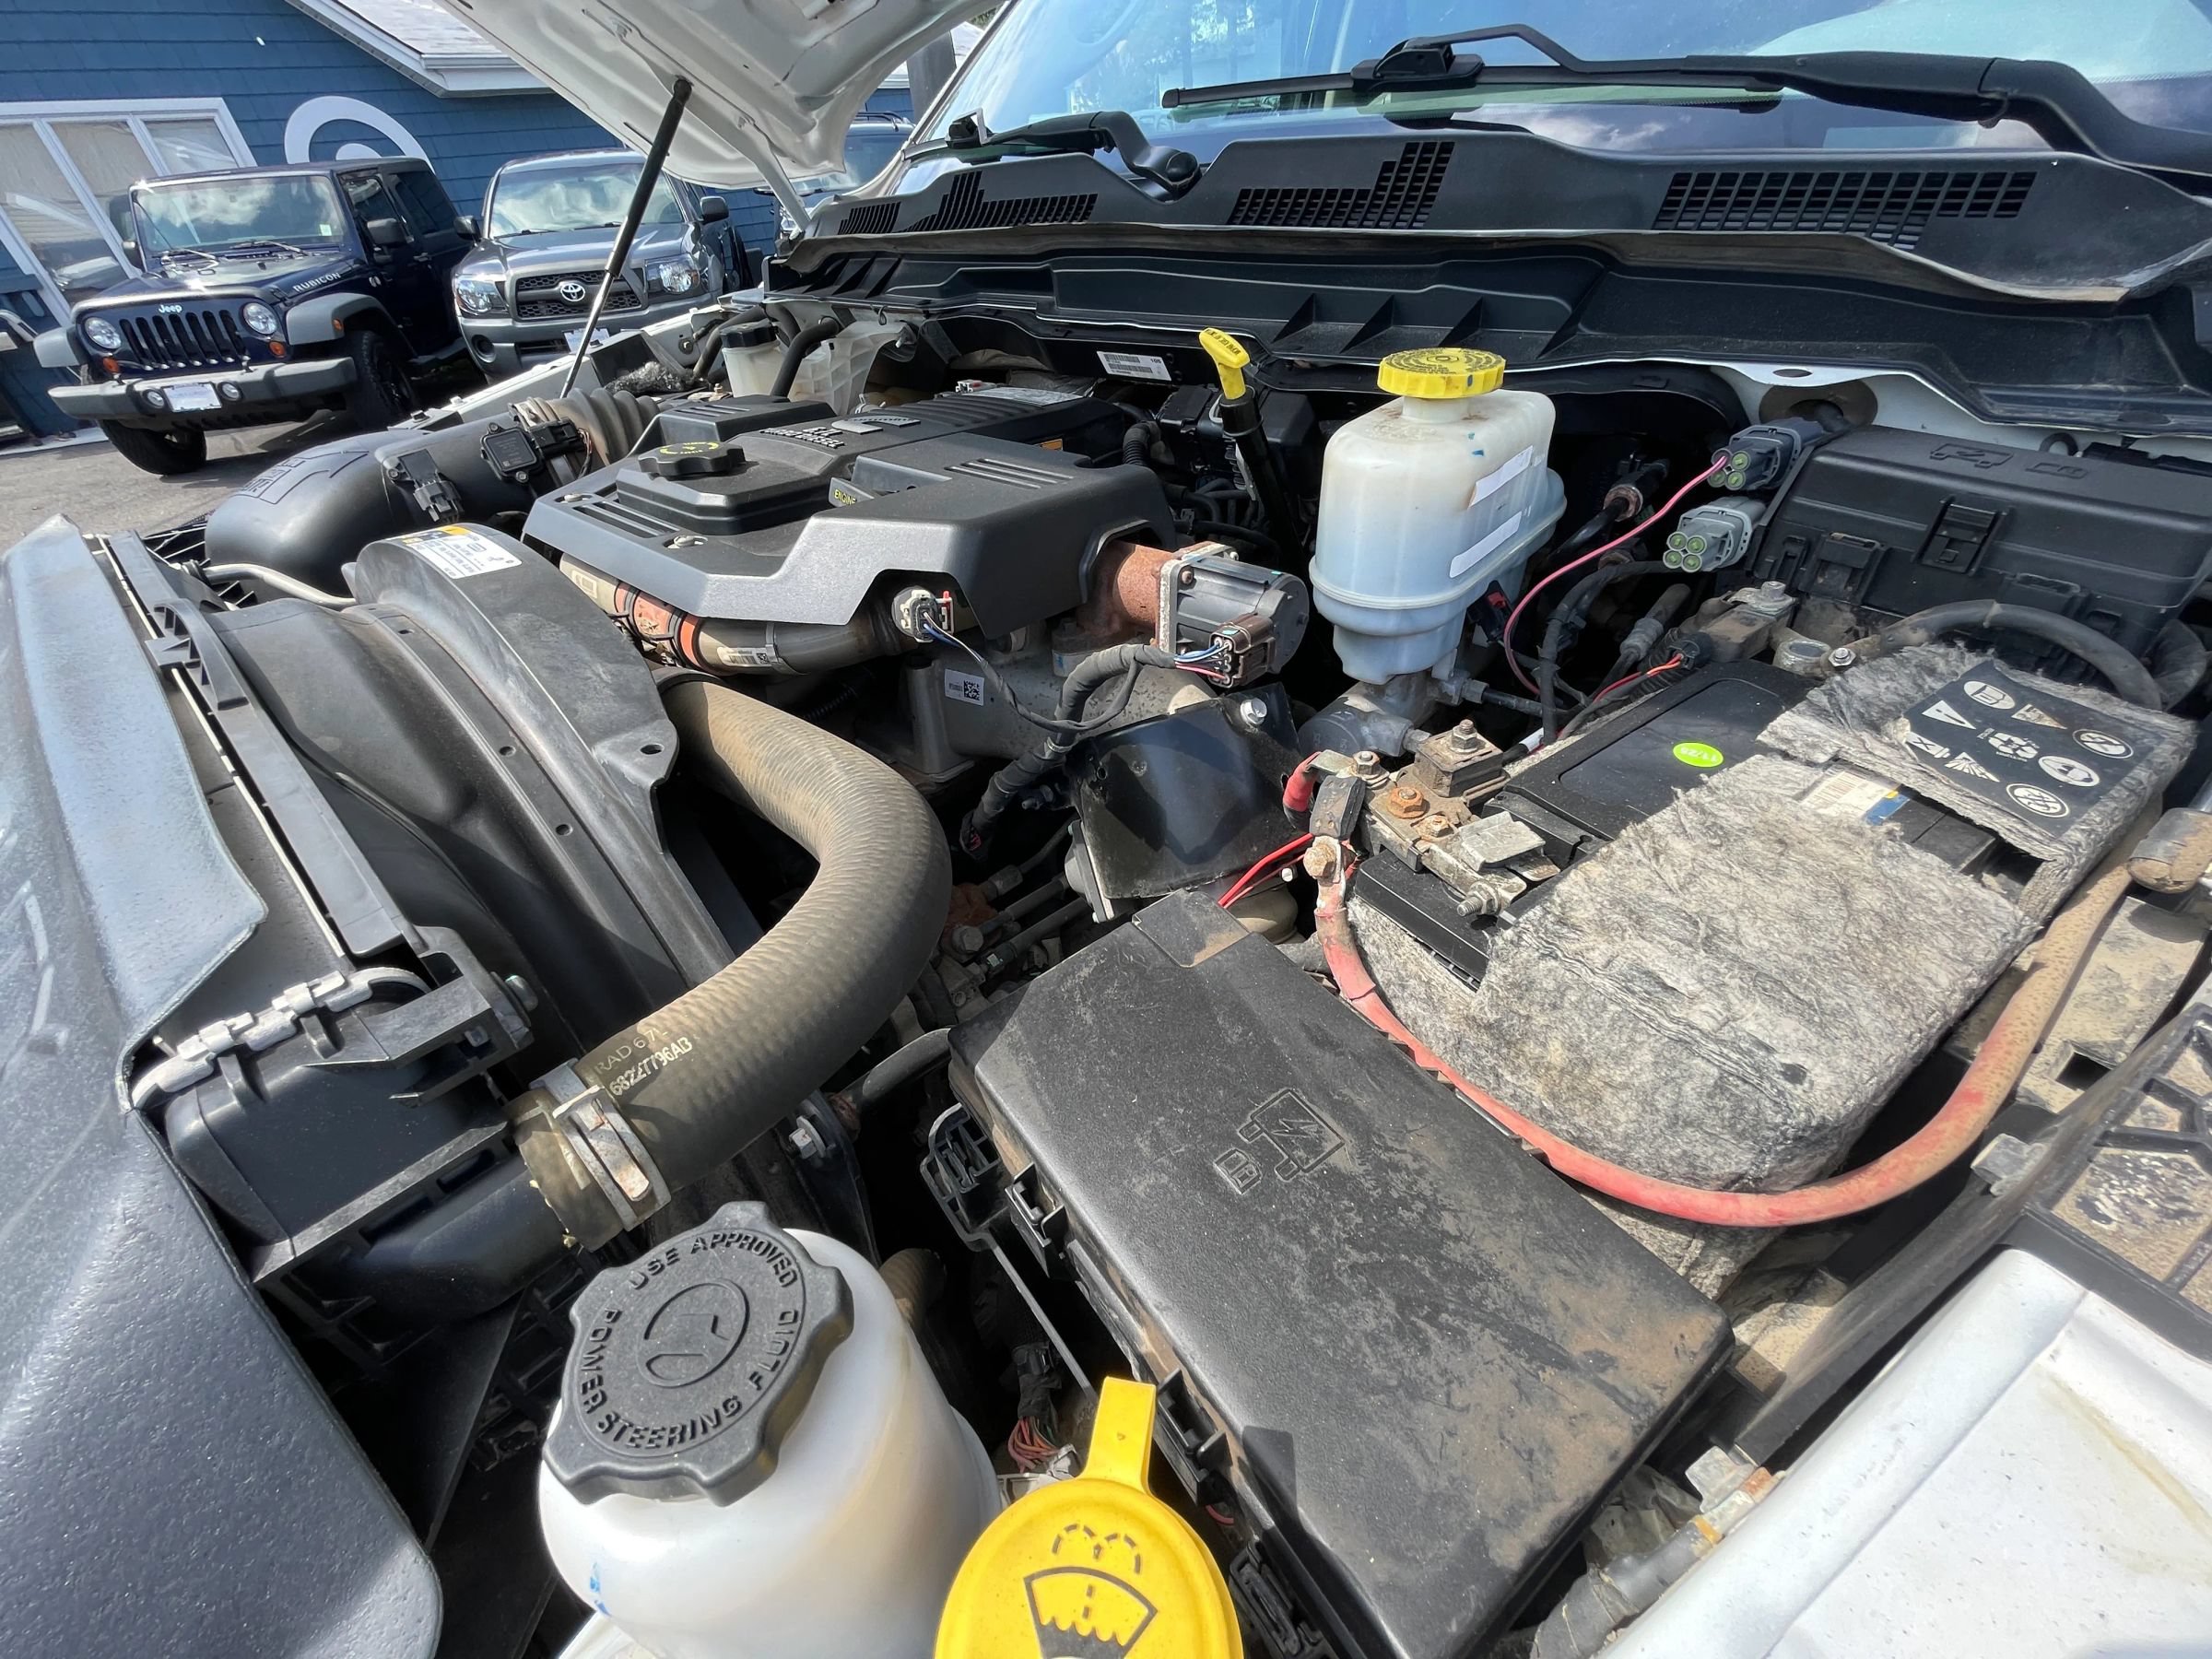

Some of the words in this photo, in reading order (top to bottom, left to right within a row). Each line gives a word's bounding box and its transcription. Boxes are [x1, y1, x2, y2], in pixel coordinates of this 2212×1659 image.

[158, 304, 183, 313] Jeep
[293, 272, 341, 293] RUBICON
[594, 1045, 632, 1075] RAD
[627, 1247, 680, 1290] USE
[690, 1232, 798, 1288] APPROVED
[581, 1307, 622, 1415] POWER
[748, 1309, 799, 1392] FLUID
[596, 1394, 744, 1450] STEERING
